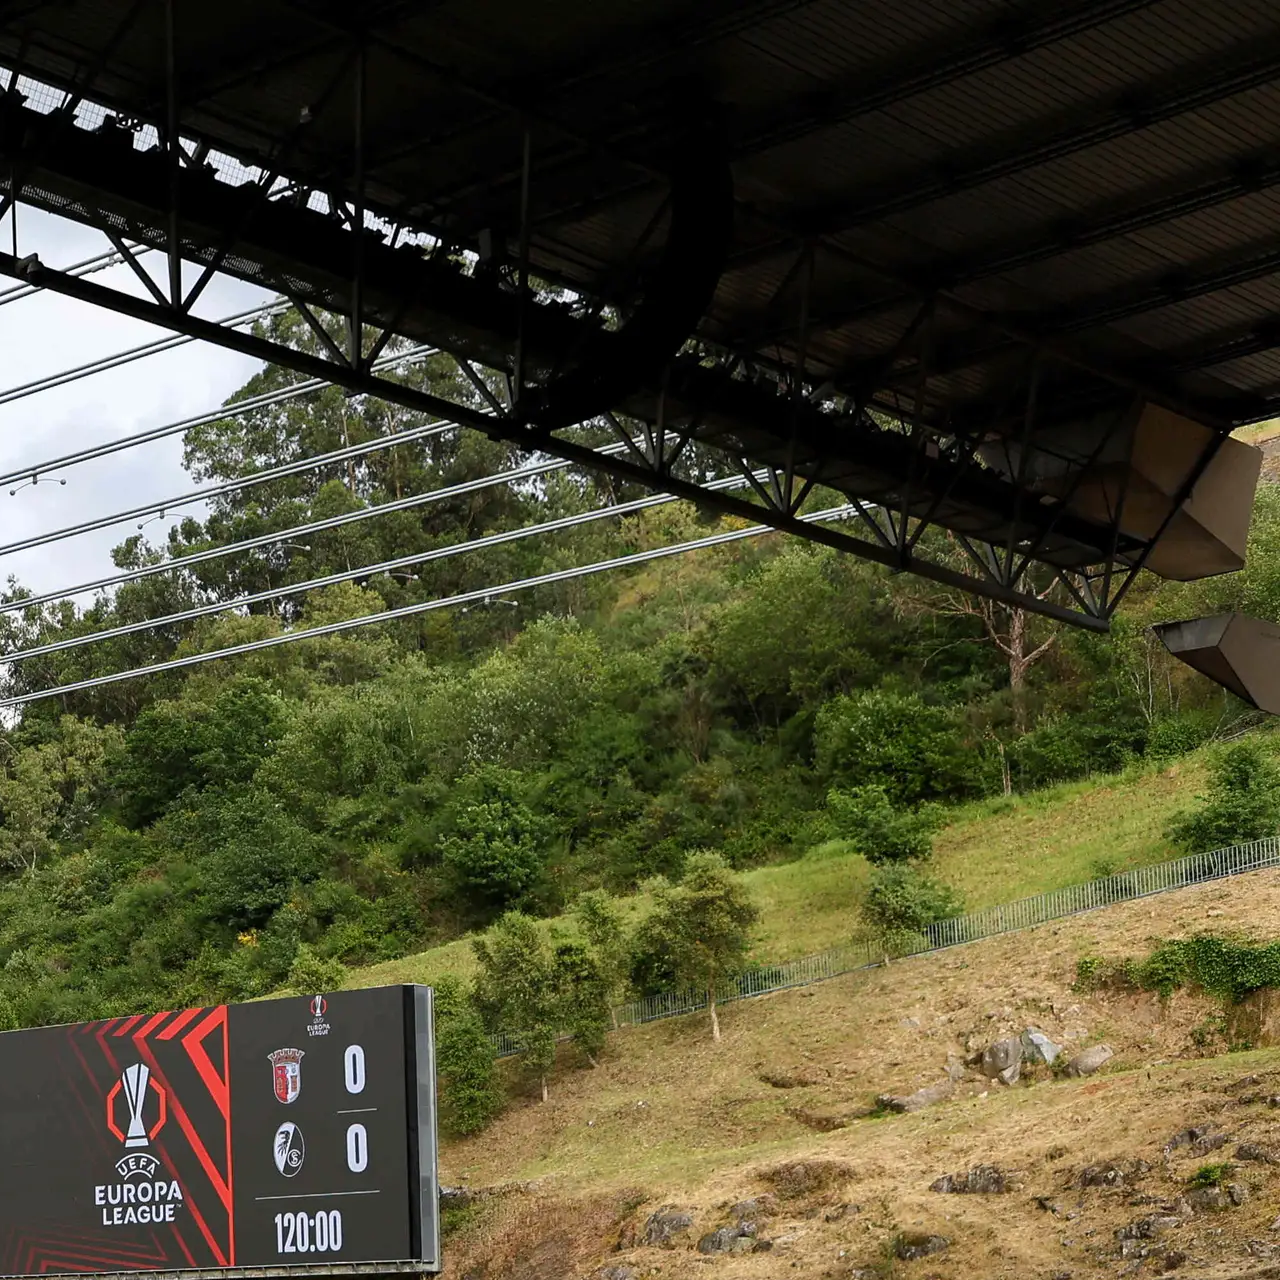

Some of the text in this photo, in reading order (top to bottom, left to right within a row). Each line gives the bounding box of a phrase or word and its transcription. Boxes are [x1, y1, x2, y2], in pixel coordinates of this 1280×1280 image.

[344, 1044, 365, 1094] 0
[346, 1123, 368, 1173] 0
[117, 1158, 156, 1175] UEFA
[95, 1181, 183, 1205] EUROPA
[102, 1204, 176, 1226] LEAGUE
[274, 1210, 342, 1253] 120:00
